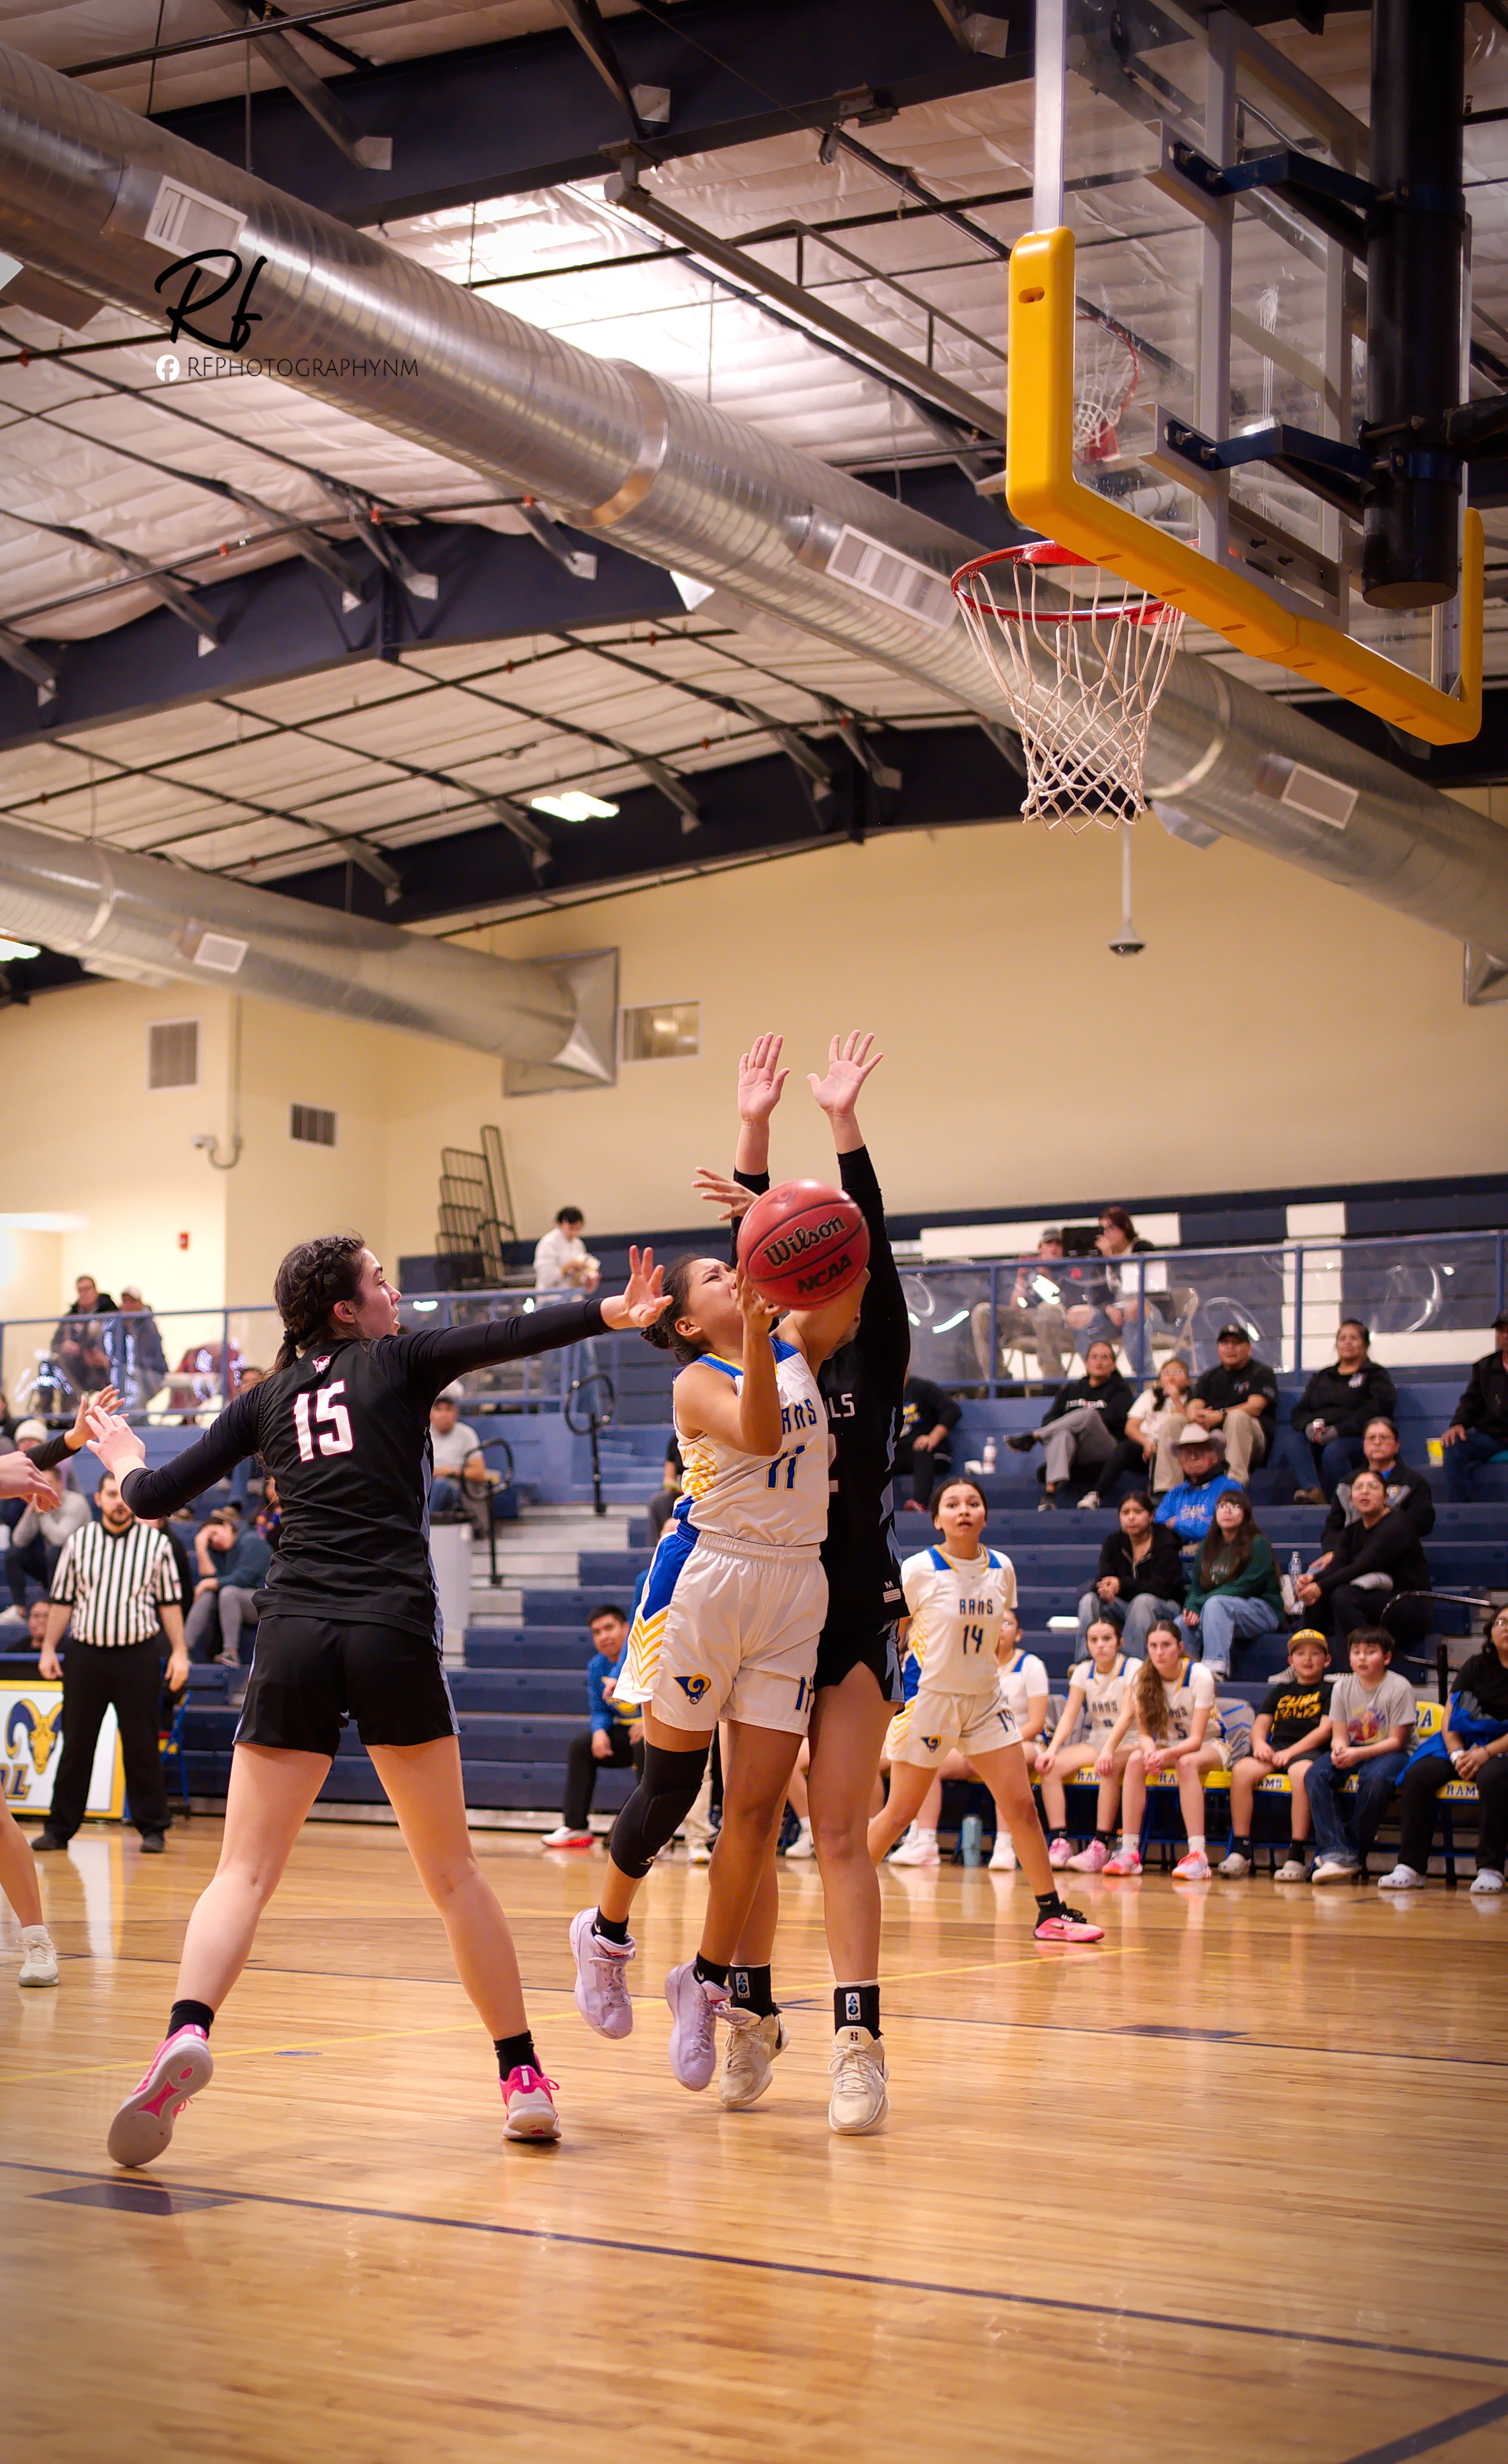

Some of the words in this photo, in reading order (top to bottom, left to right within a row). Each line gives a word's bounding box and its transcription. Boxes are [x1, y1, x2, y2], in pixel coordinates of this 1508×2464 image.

[762, 1216, 847, 1268] Wilson
[796, 1253, 853, 1294] NCAA
[292, 1378, 355, 1464] 15
[780, 1396, 818, 1436] AMS
[765, 1442, 808, 1491] 11
[884, 1580, 894, 1589] M
[963, 1624, 984, 1655] 14
[1445, 1783, 1479, 1797] RAM
